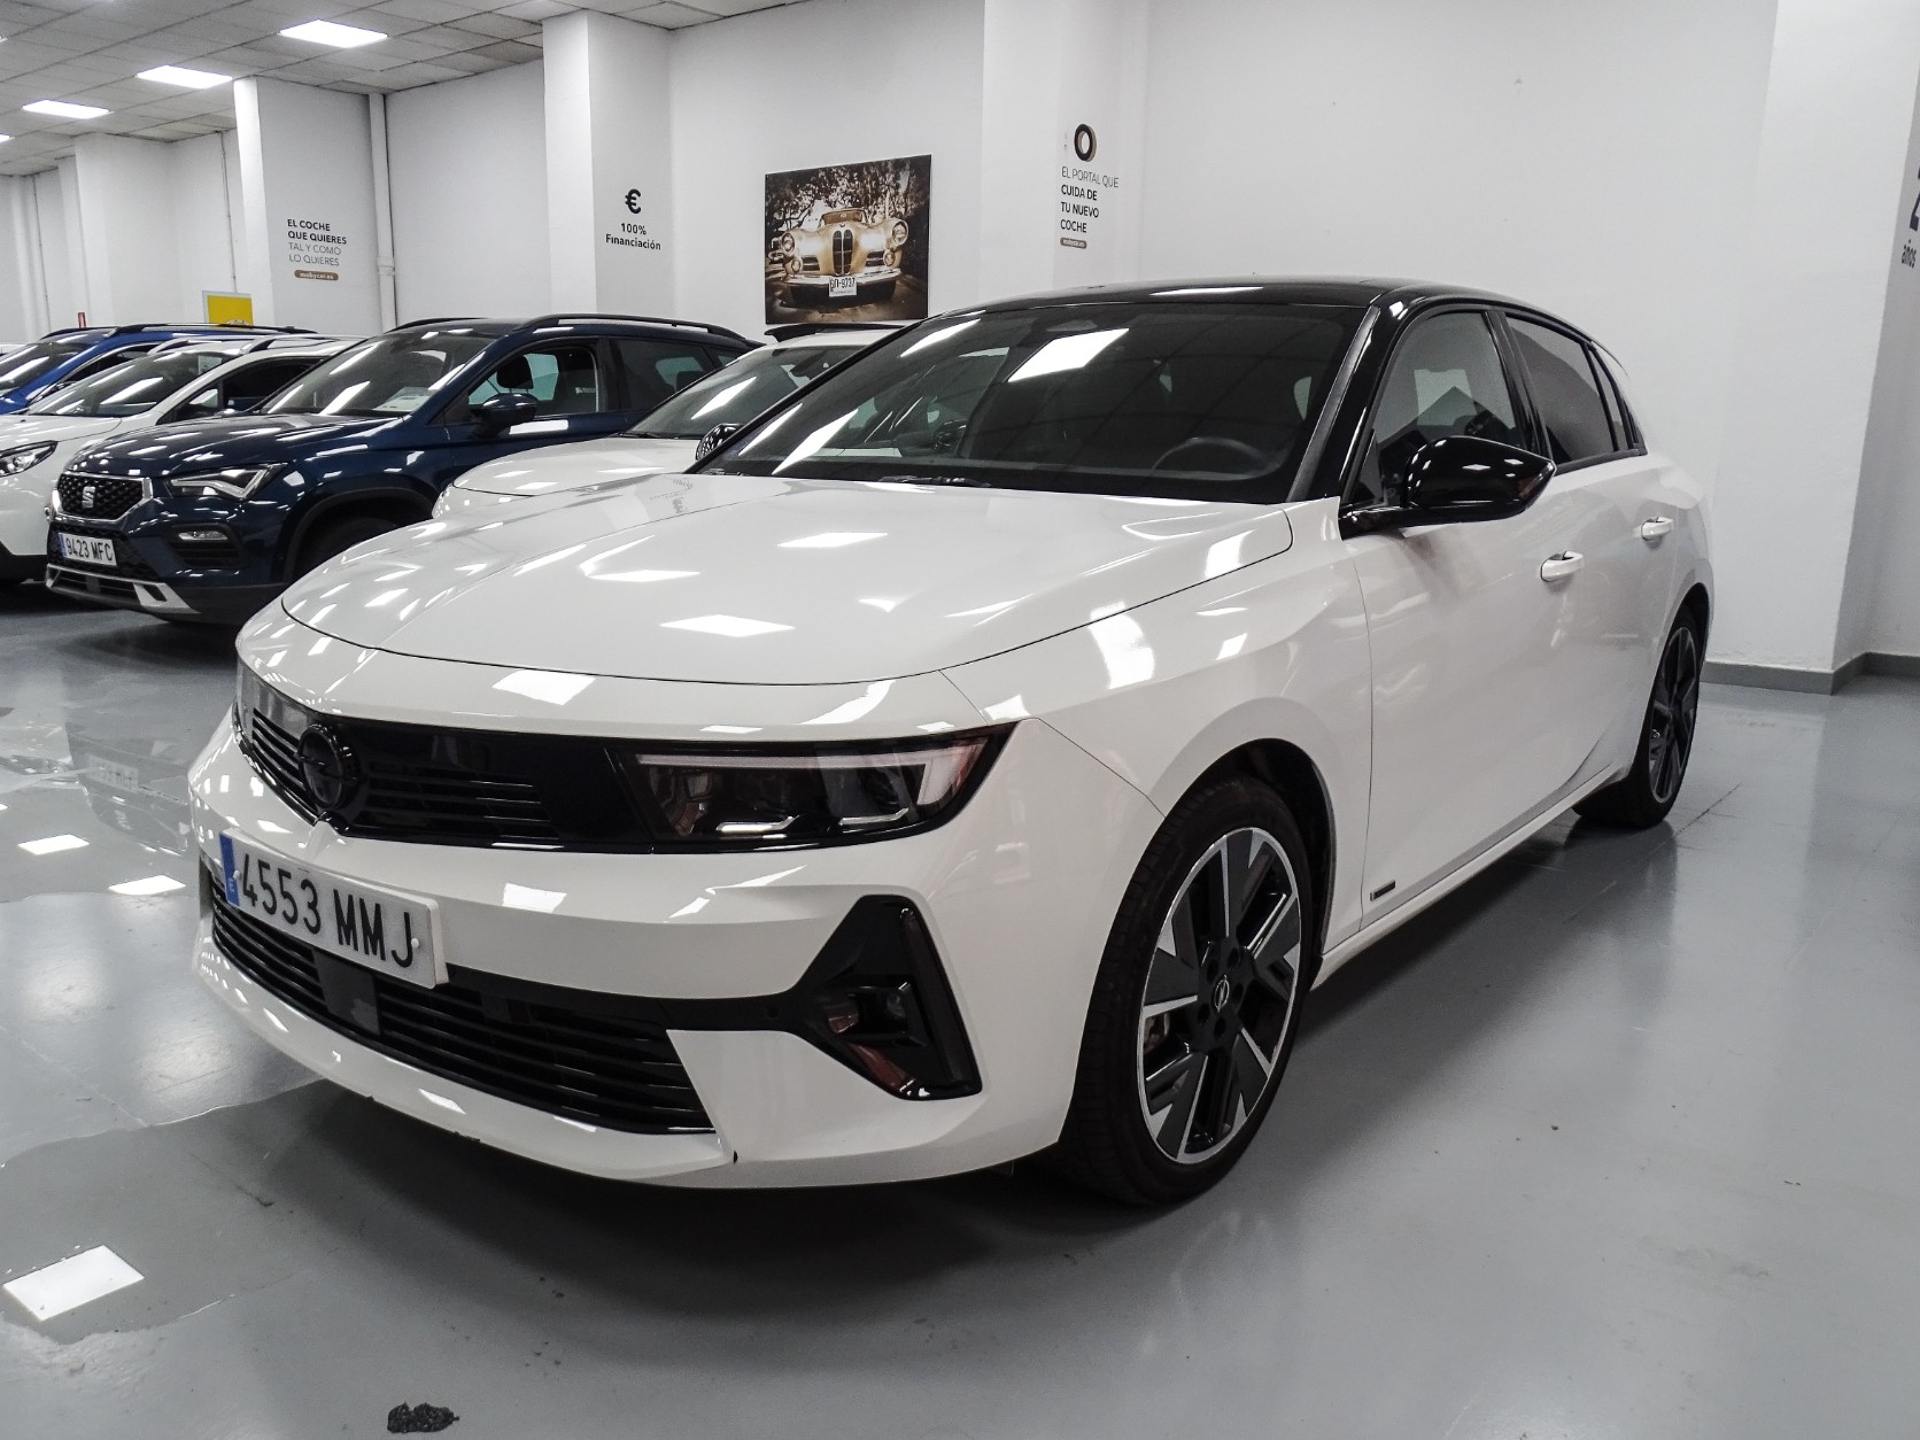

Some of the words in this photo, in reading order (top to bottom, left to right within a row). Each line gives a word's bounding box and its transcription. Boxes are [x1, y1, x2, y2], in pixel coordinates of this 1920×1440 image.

[1061, 166, 1071, 179] EL
[1072, 168, 1101, 185] PORTAL
[1102, 175, 1119, 189] QUE
[1060, 184, 1086, 199] CUIDA
[1087, 188, 1098, 201] DE
[1060, 201, 1071, 213] TU
[1072, 203, 1100, 218] NUEVO
[287, 219, 298, 228] EL
[299, 220, 330, 231] COCHE
[620, 222, 647, 236] 100%
[1060, 219, 1087, 234] COCHE
[287, 230, 308, 241] QUE
[310, 233, 347, 245] QUIERES
[605, 233, 661, 250] Financiación
[288, 241, 304, 252] TAL
[313, 245, 341, 255] COMO
[289, 253, 301, 263] LO
[303, 255, 339, 266] QUIERES
[65, 537, 91, 559] 9423
[91, 540, 114, 562] MFC
[242, 853, 321, 935] 4553
[332, 888, 413, 969] MMJ
